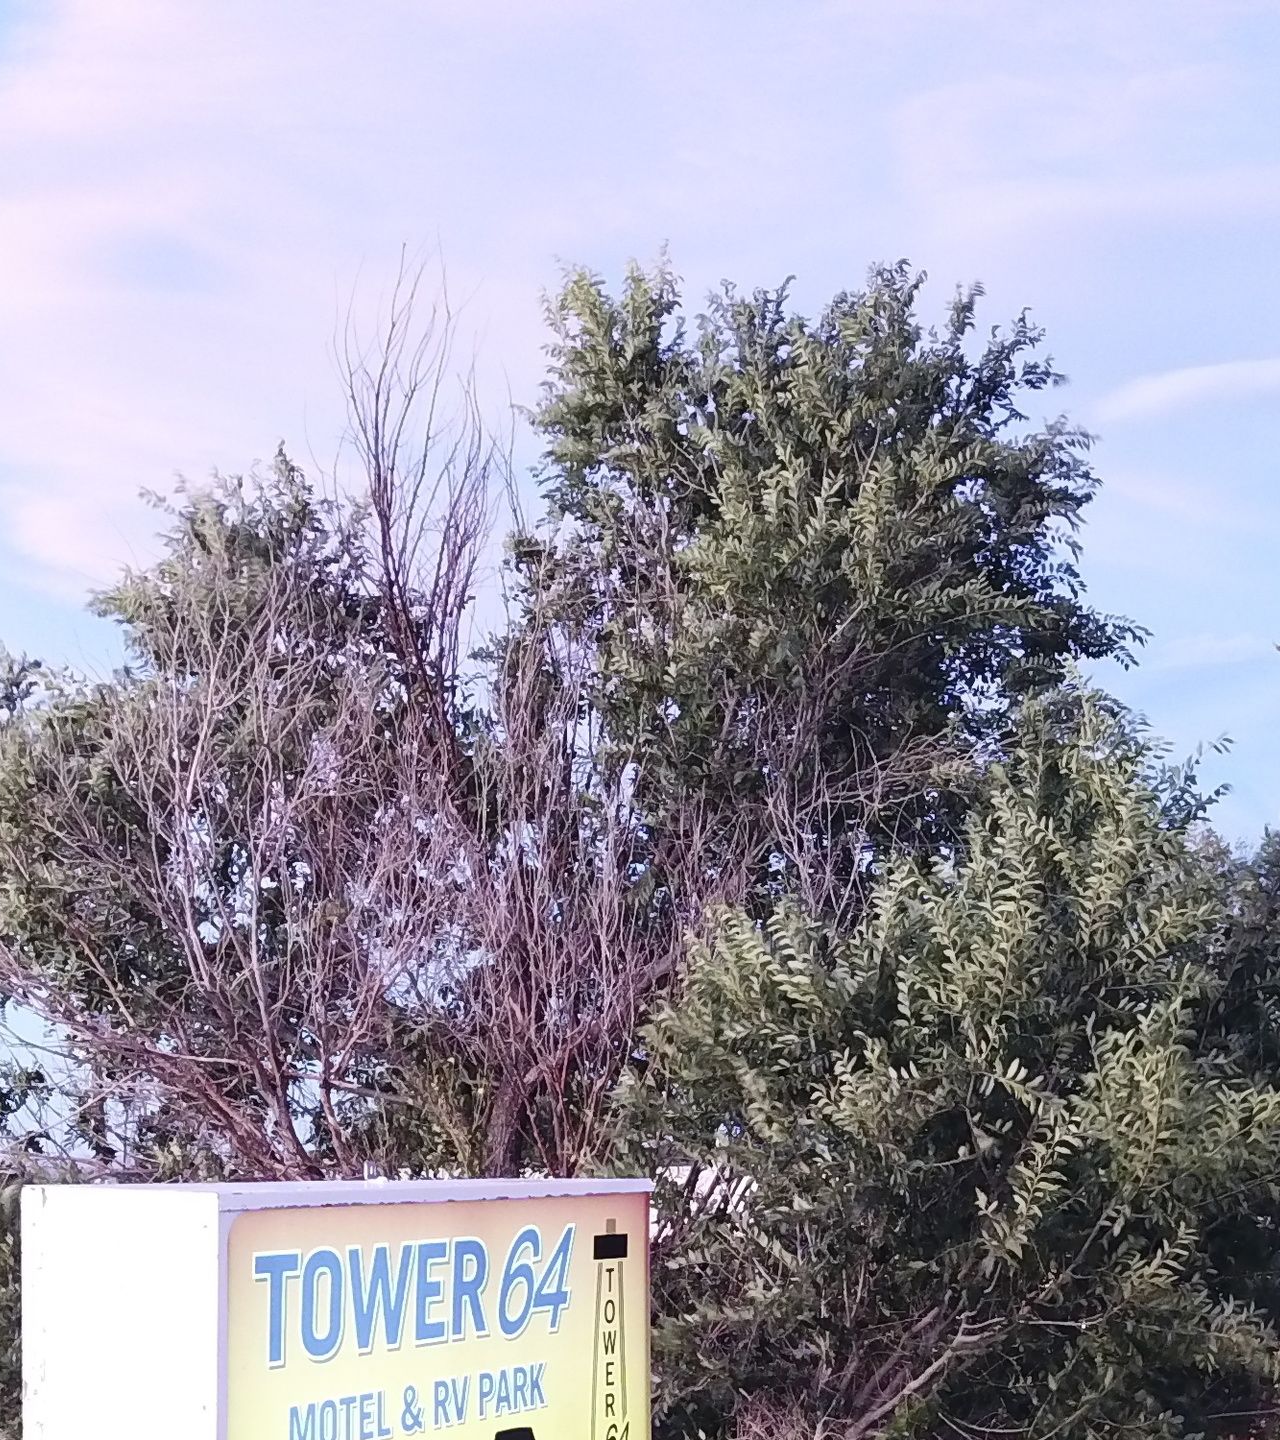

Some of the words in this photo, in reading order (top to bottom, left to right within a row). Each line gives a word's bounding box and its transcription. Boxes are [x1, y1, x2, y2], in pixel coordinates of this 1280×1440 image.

[252, 1237, 489, 1368] TOWER
[498, 1223, 576, 1340] 64
[603, 1267, 617, 1418] TOWER
[400, 1384, 425, 1437] &
[433, 1374, 472, 1429] RV
[478, 1361, 549, 1423] PARK
